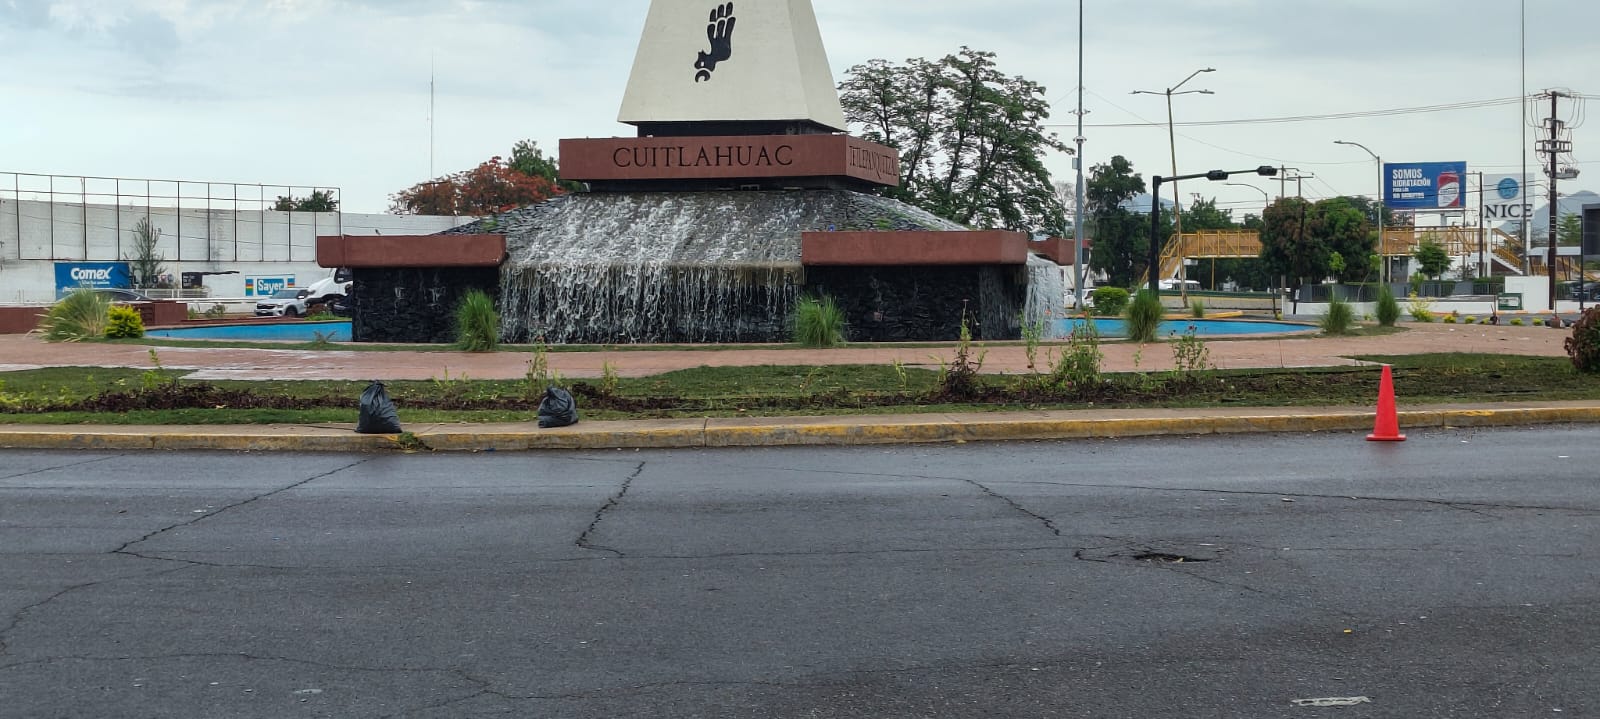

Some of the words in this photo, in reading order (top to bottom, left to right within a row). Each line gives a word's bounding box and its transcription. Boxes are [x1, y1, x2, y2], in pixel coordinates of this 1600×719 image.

[613, 145, 793, 167] CUITLAHUAC
[1392, 168, 1423, 179] SOMOS
[1484, 204, 1533, 218] NICE
[70, 266, 114, 281] Comex
[257, 279, 284, 294] Sayer
